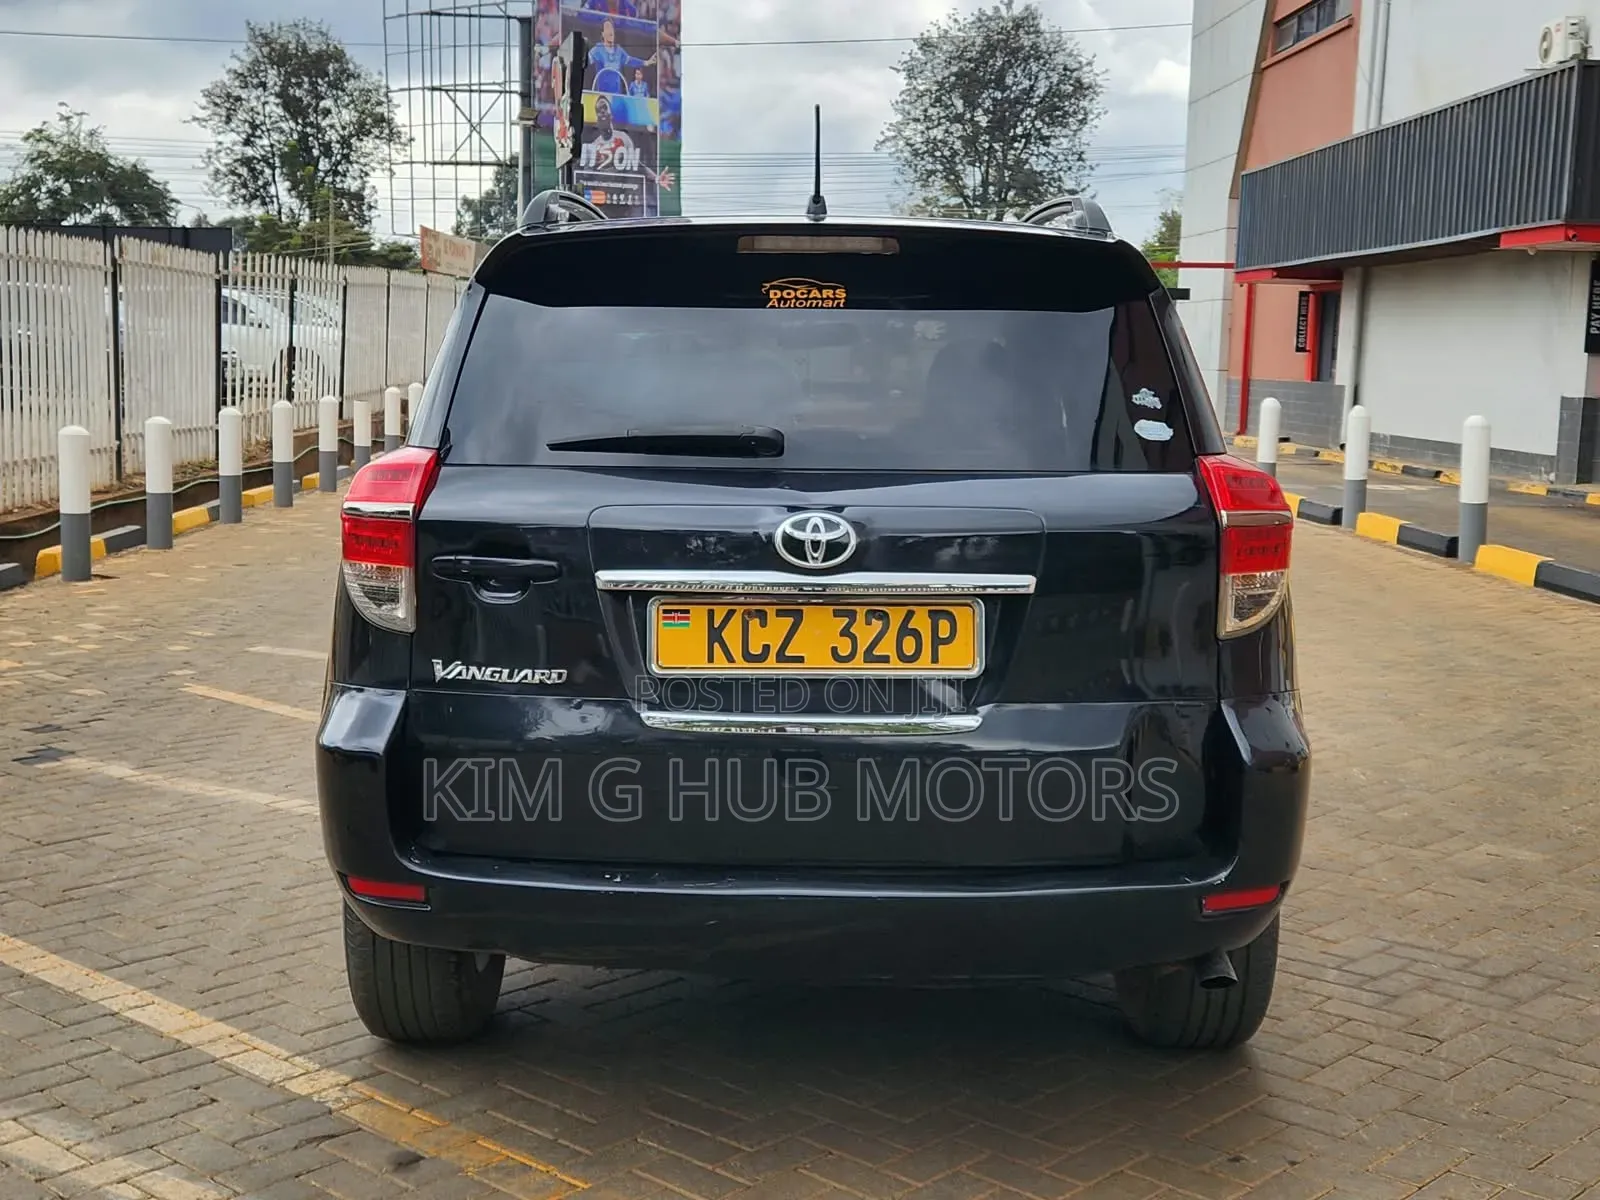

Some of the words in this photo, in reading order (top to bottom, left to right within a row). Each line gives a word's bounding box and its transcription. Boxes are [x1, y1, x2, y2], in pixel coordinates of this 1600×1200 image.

[769, 289, 847, 299] DOCARS
[766, 299, 846, 308] Automart
[706, 608, 805, 664] KCZ
[830, 609, 957, 664] 326P
